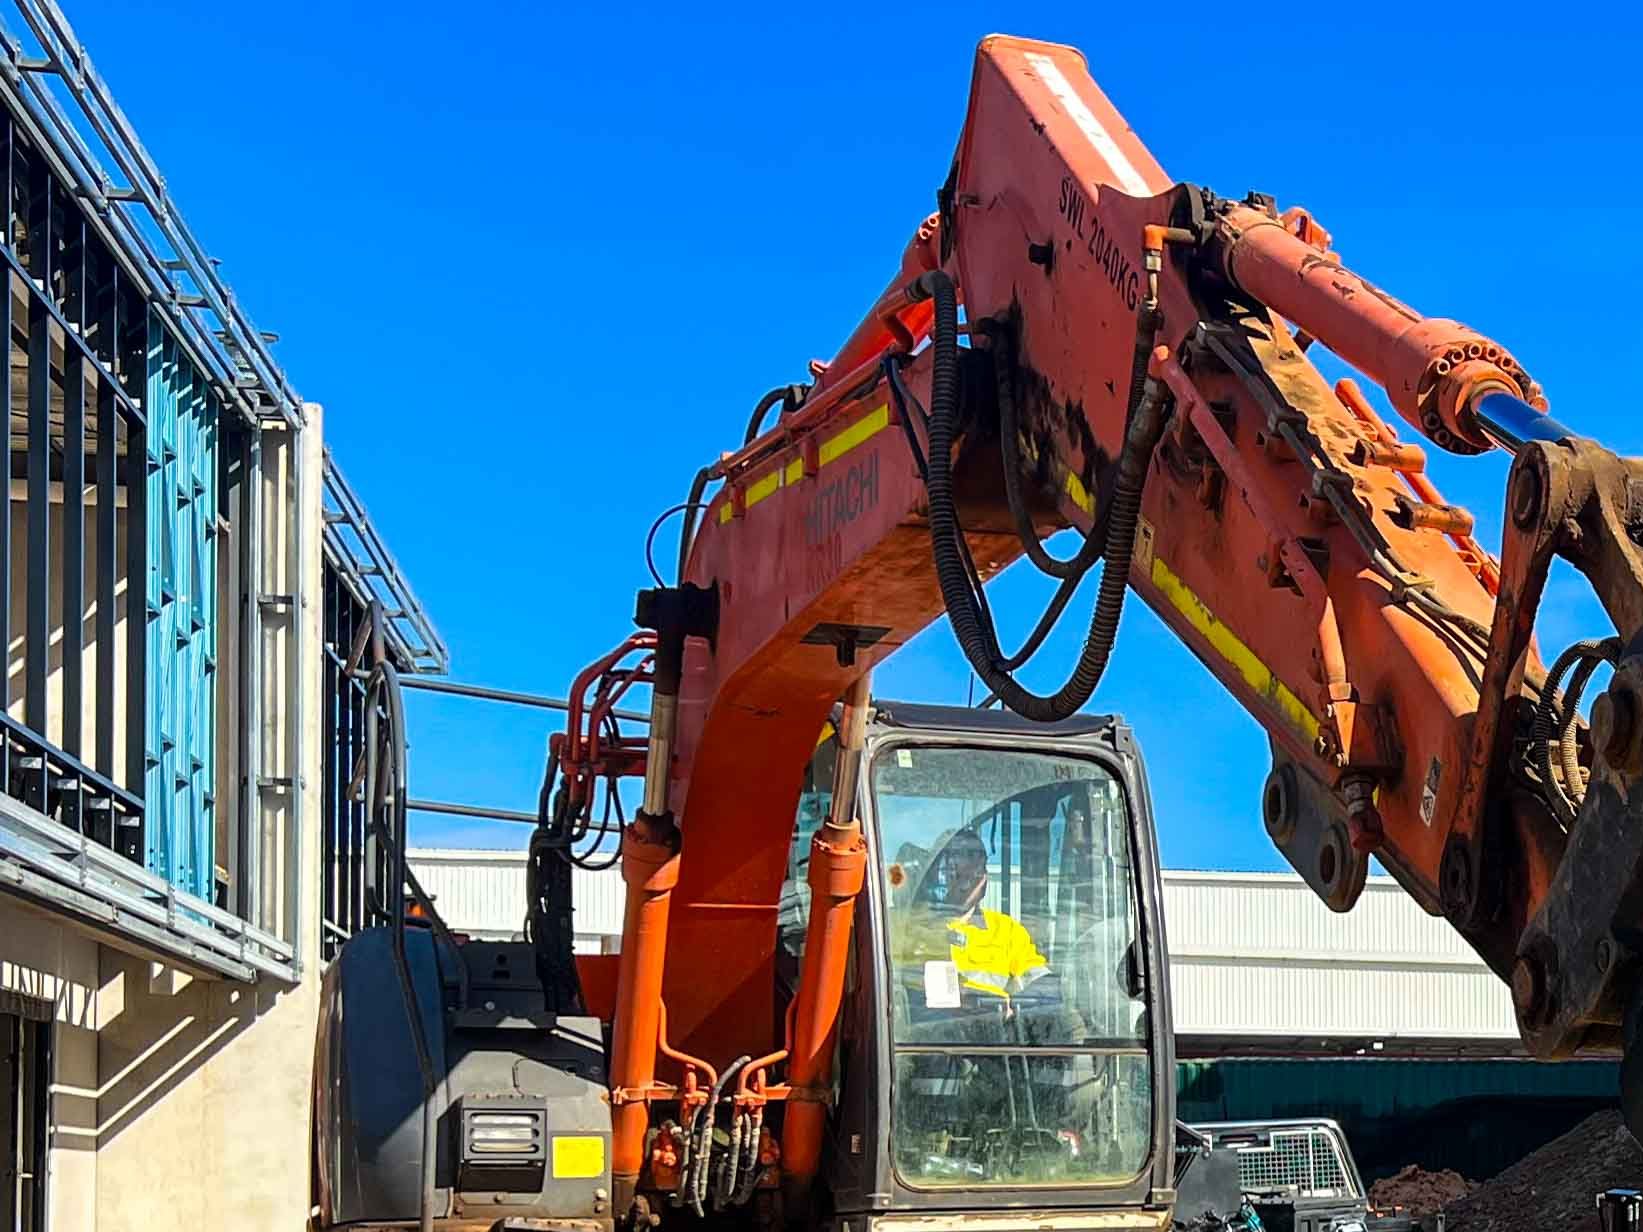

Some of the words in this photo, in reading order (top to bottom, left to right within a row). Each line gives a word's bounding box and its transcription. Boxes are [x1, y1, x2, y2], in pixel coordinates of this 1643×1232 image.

[1059, 176, 1085, 240] SWL
[1088, 216, 1139, 312] 2040KG
[804, 448, 879, 545] HITACHI
